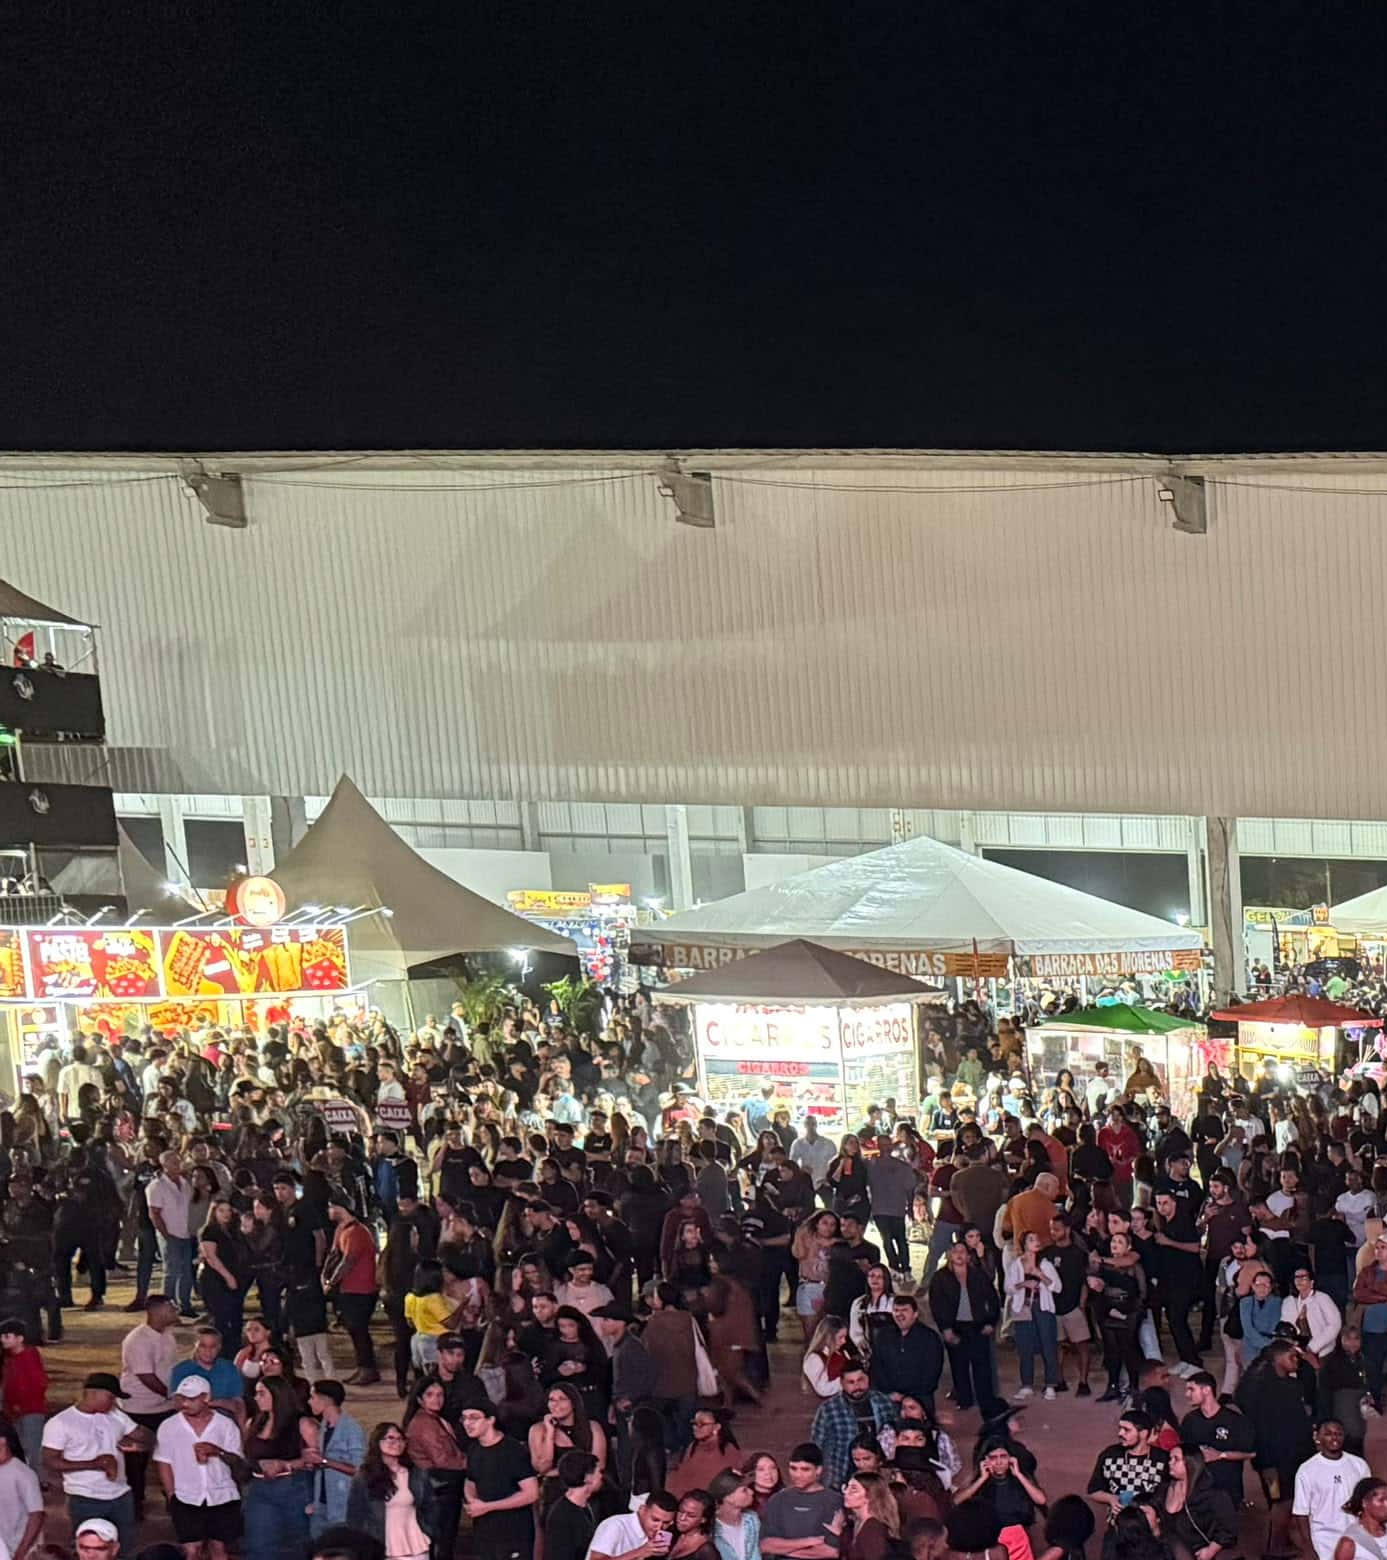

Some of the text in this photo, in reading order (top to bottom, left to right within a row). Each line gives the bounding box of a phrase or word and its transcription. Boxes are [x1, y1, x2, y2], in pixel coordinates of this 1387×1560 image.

[1035, 954, 1094, 976] BARRACA
[1096, 953, 1119, 974] DAS
[1121, 951, 1174, 973] MORENAS
